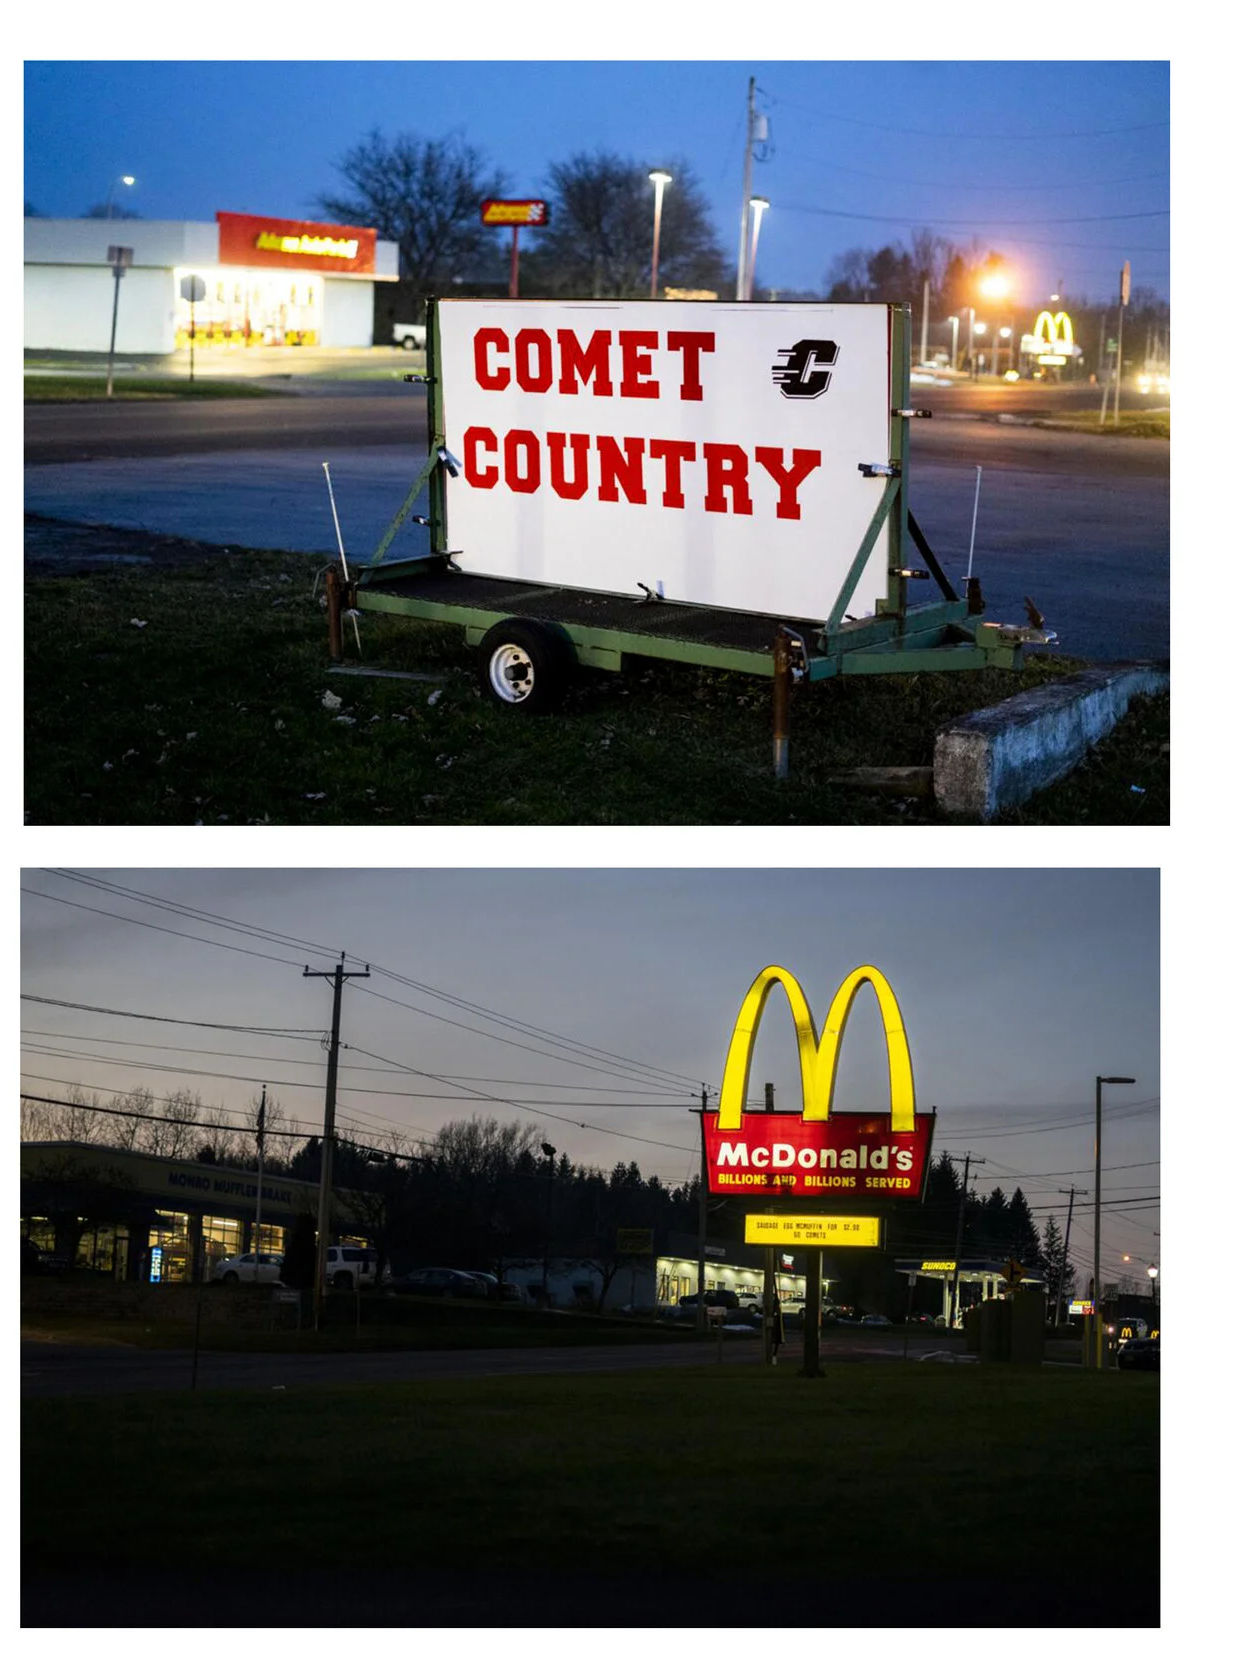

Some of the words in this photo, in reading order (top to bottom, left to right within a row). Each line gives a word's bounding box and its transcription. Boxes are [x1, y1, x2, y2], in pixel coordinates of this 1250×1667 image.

[473, 327, 716, 401] COMET
[771, 339, 840, 400] C
[463, 426, 822, 520] COUNTRY
[716, 1142, 913, 1171] McDonald's
[718, 1173, 768, 1186] BILLIONS
[772, 1175, 797, 1187] AND
[804, 1176, 857, 1188] BILLIONS
[865, 1178, 912, 1189] SERVED
[756, 1221, 779, 1230] SAUSAGE
[796, 1222, 823, 1230] MCMUFFIN
[827, 1223, 838, 1231] FOR
[793, 1231, 801, 1239] GO
[805, 1231, 827, 1239] COMETS
[921, 1261, 957, 1271] SUNOCO
